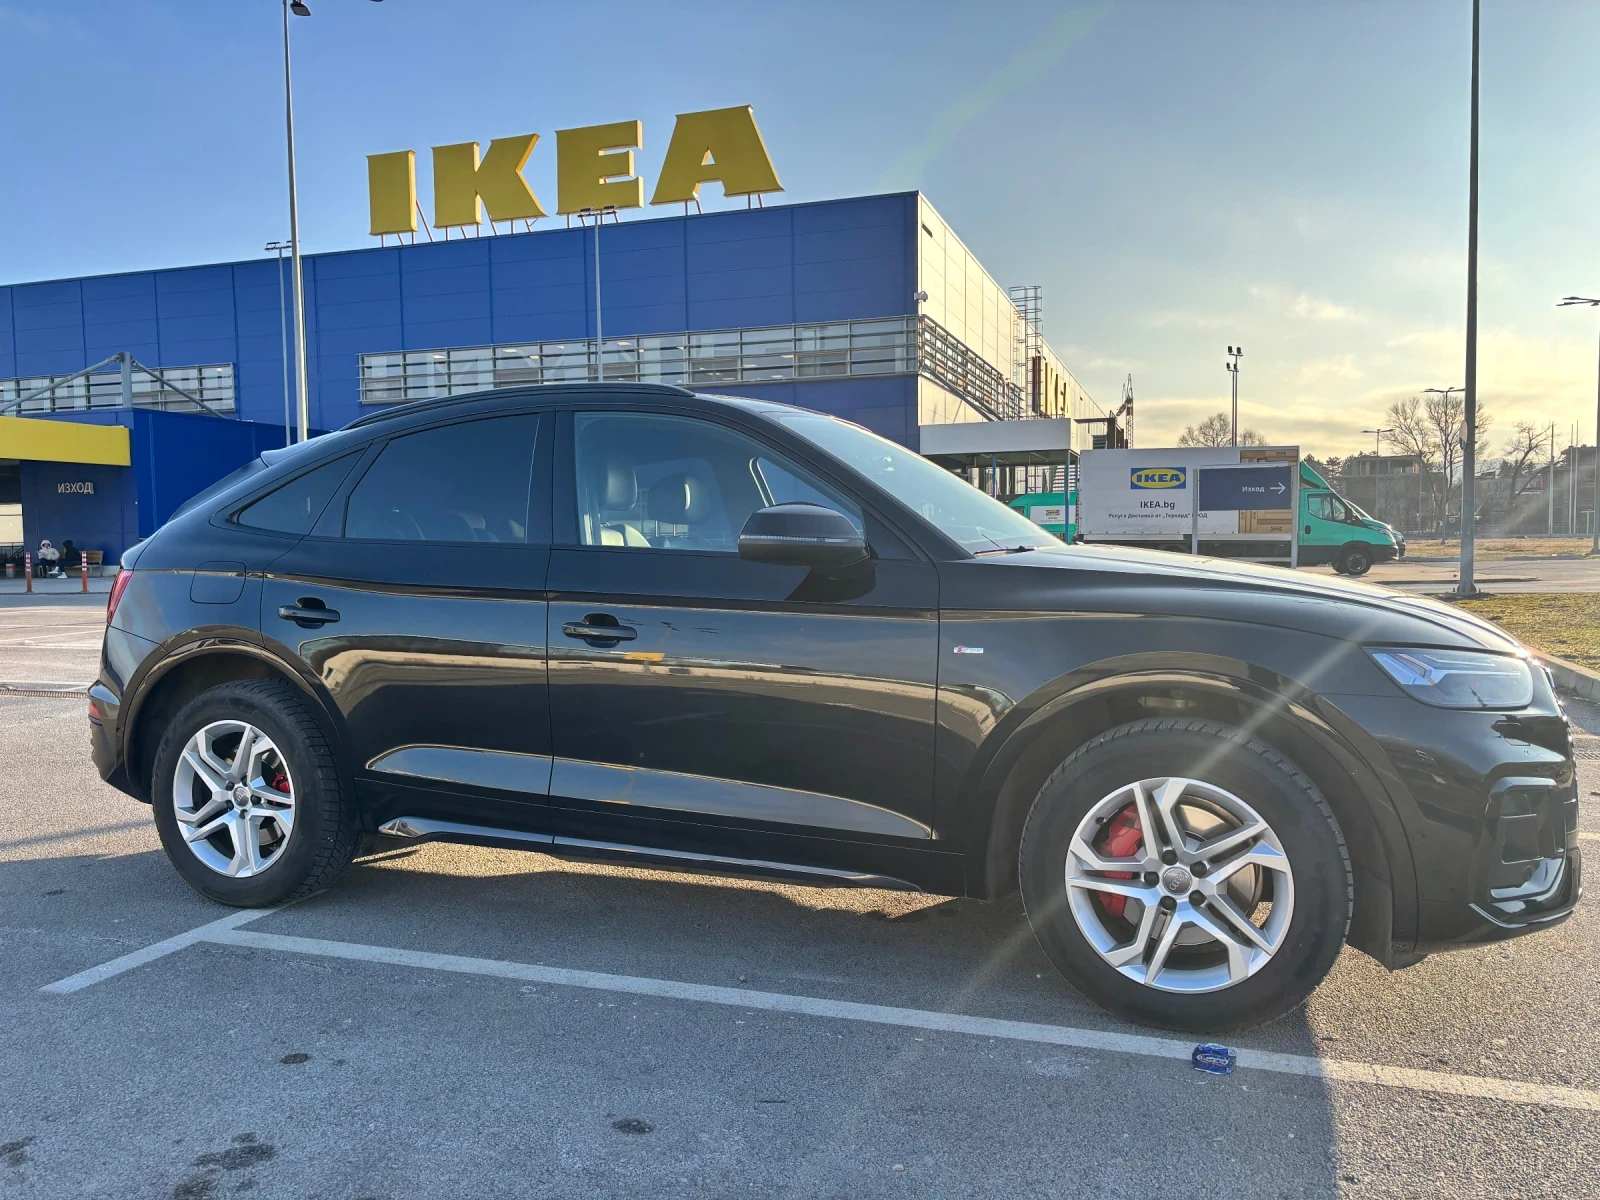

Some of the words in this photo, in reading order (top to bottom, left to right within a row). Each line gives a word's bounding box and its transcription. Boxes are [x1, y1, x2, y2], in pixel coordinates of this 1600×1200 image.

[367, 104, 785, 236] IKEA
[1136, 473, 1182, 483] IKEA
[57, 482, 95, 495] ИЗХОД
[1140, 500, 1176, 511] IKEA.bg
